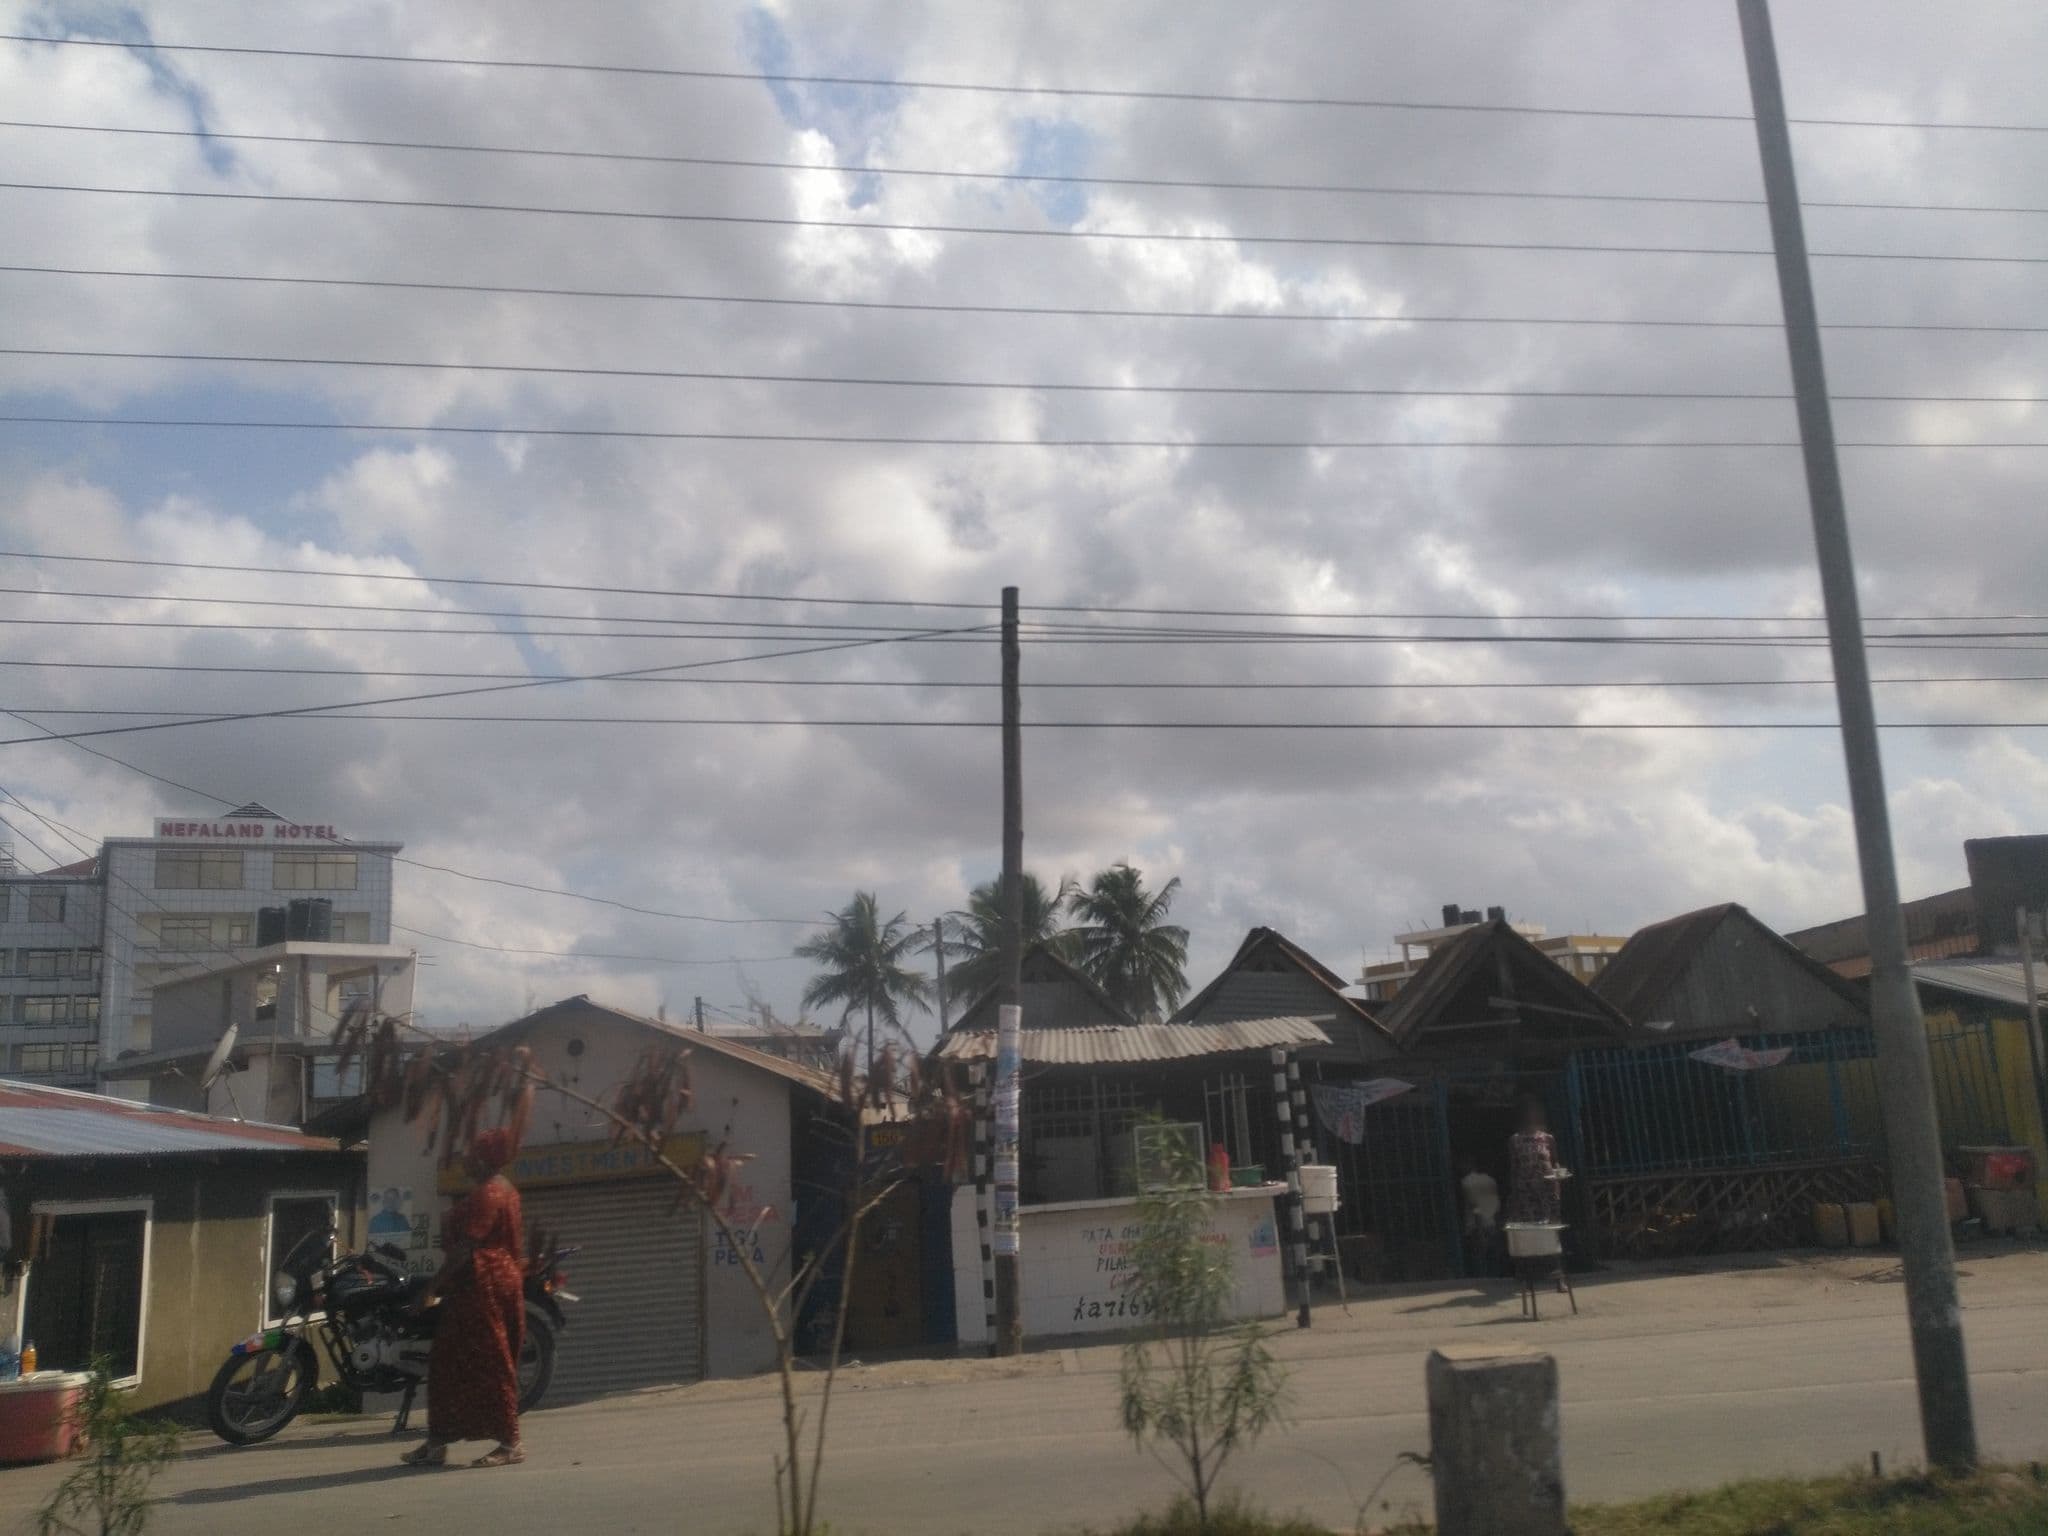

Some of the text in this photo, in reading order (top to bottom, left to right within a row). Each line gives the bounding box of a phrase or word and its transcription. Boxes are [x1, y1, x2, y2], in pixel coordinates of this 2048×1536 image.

[160, 822, 338, 839] NEFALAND HOTEL
[715, 1229, 759, 1248] TGO
[715, 1248, 764, 1266] PEA
